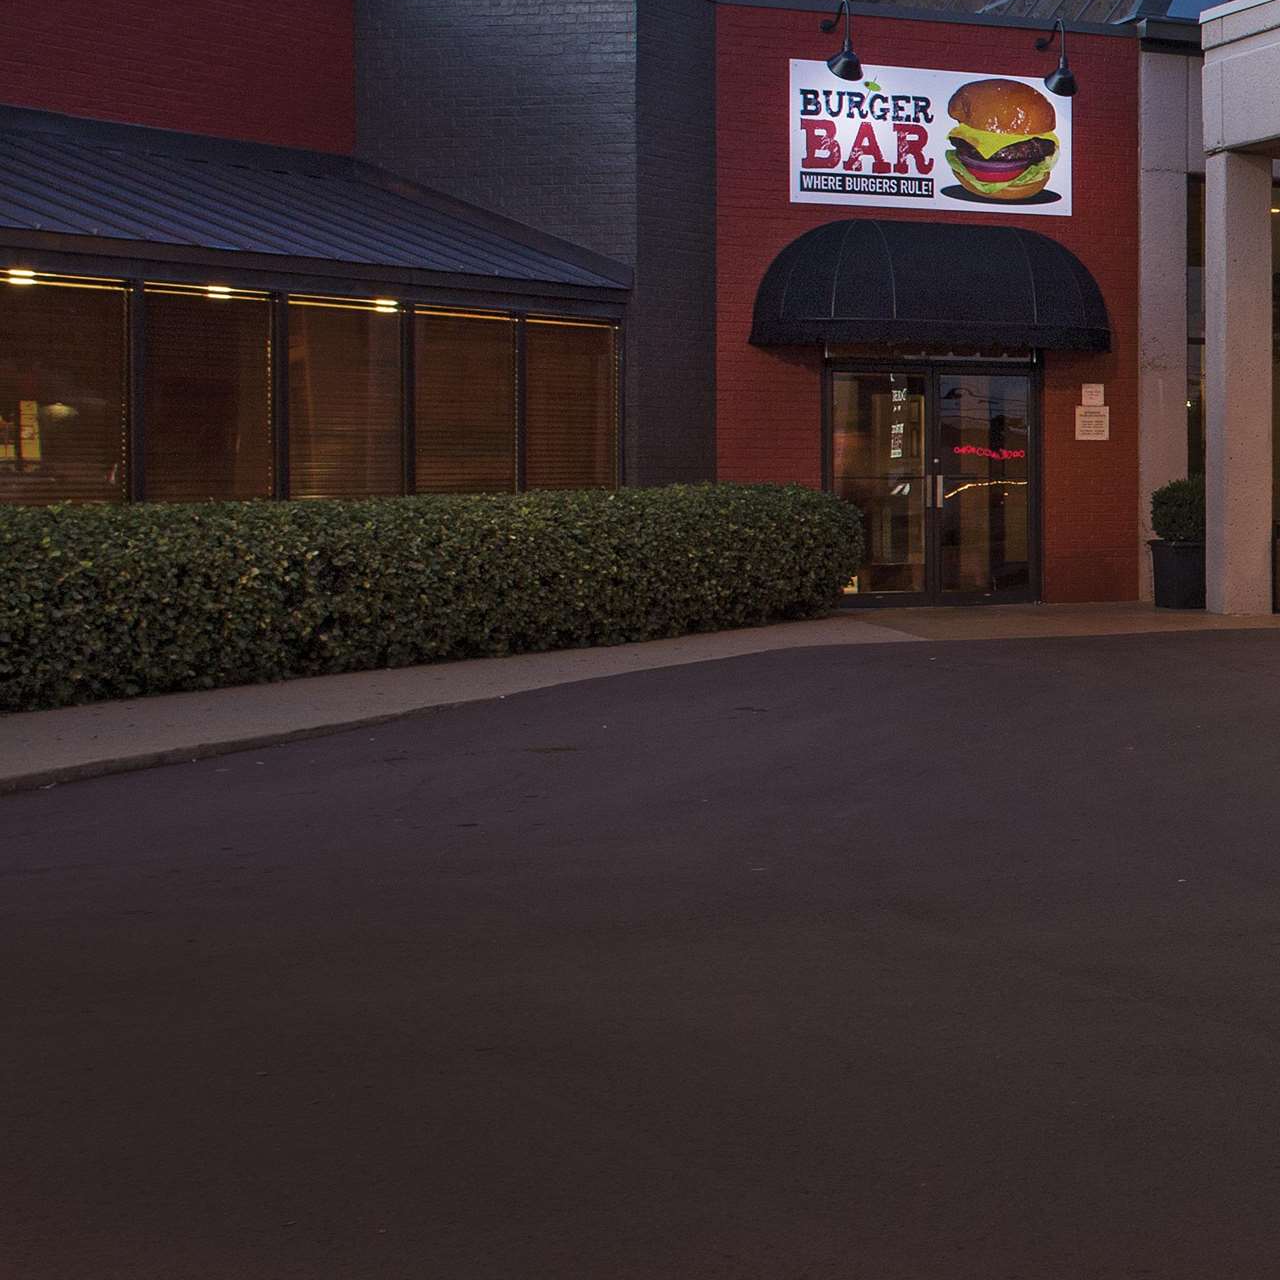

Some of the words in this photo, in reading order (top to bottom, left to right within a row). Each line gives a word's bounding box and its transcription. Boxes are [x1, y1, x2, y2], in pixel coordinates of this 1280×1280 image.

[800, 89, 934, 124] BURGER
[800, 119, 935, 174] BAR
[803, 174, 842, 190] WHERE
[845, 177, 897, 193] BURGERS
[900, 180, 933, 195] RULE!
